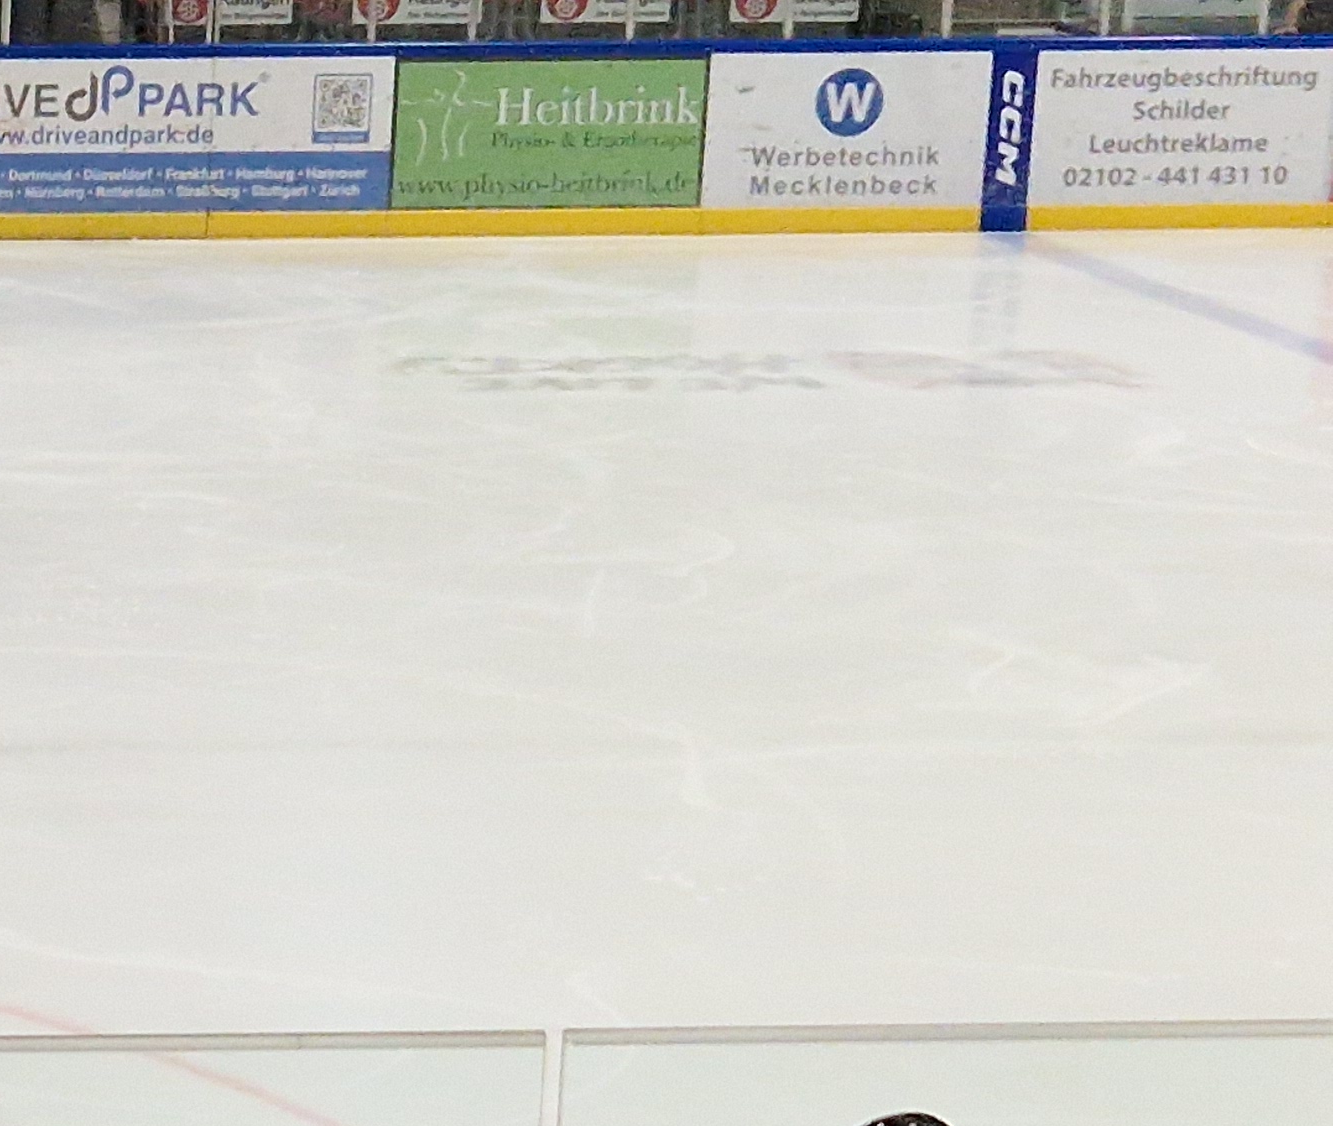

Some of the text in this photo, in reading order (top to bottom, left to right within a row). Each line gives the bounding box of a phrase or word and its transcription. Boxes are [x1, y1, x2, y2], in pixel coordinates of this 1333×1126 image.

[1050, 65, 1318, 92] Fahrzeugbeschriftung
[138, 81, 259, 117] PARK
[495, 85, 699, 126] Heitbrink
[825, 81, 876, 123] W
[1132, 100, 1230, 120] Schilder
[994, 69, 1026, 187] CCM
[750, 145, 940, 167] Werbetechnik
[1088, 134, 1268, 154] Leuchtreklame
[749, 174, 937, 195] Mecklenbeck
[1063, 167, 1134, 187] 02102
[1158, 166, 1200, 186] 441
[1209, 166, 1249, 185] 431
[1262, 166, 1288, 185] 10
